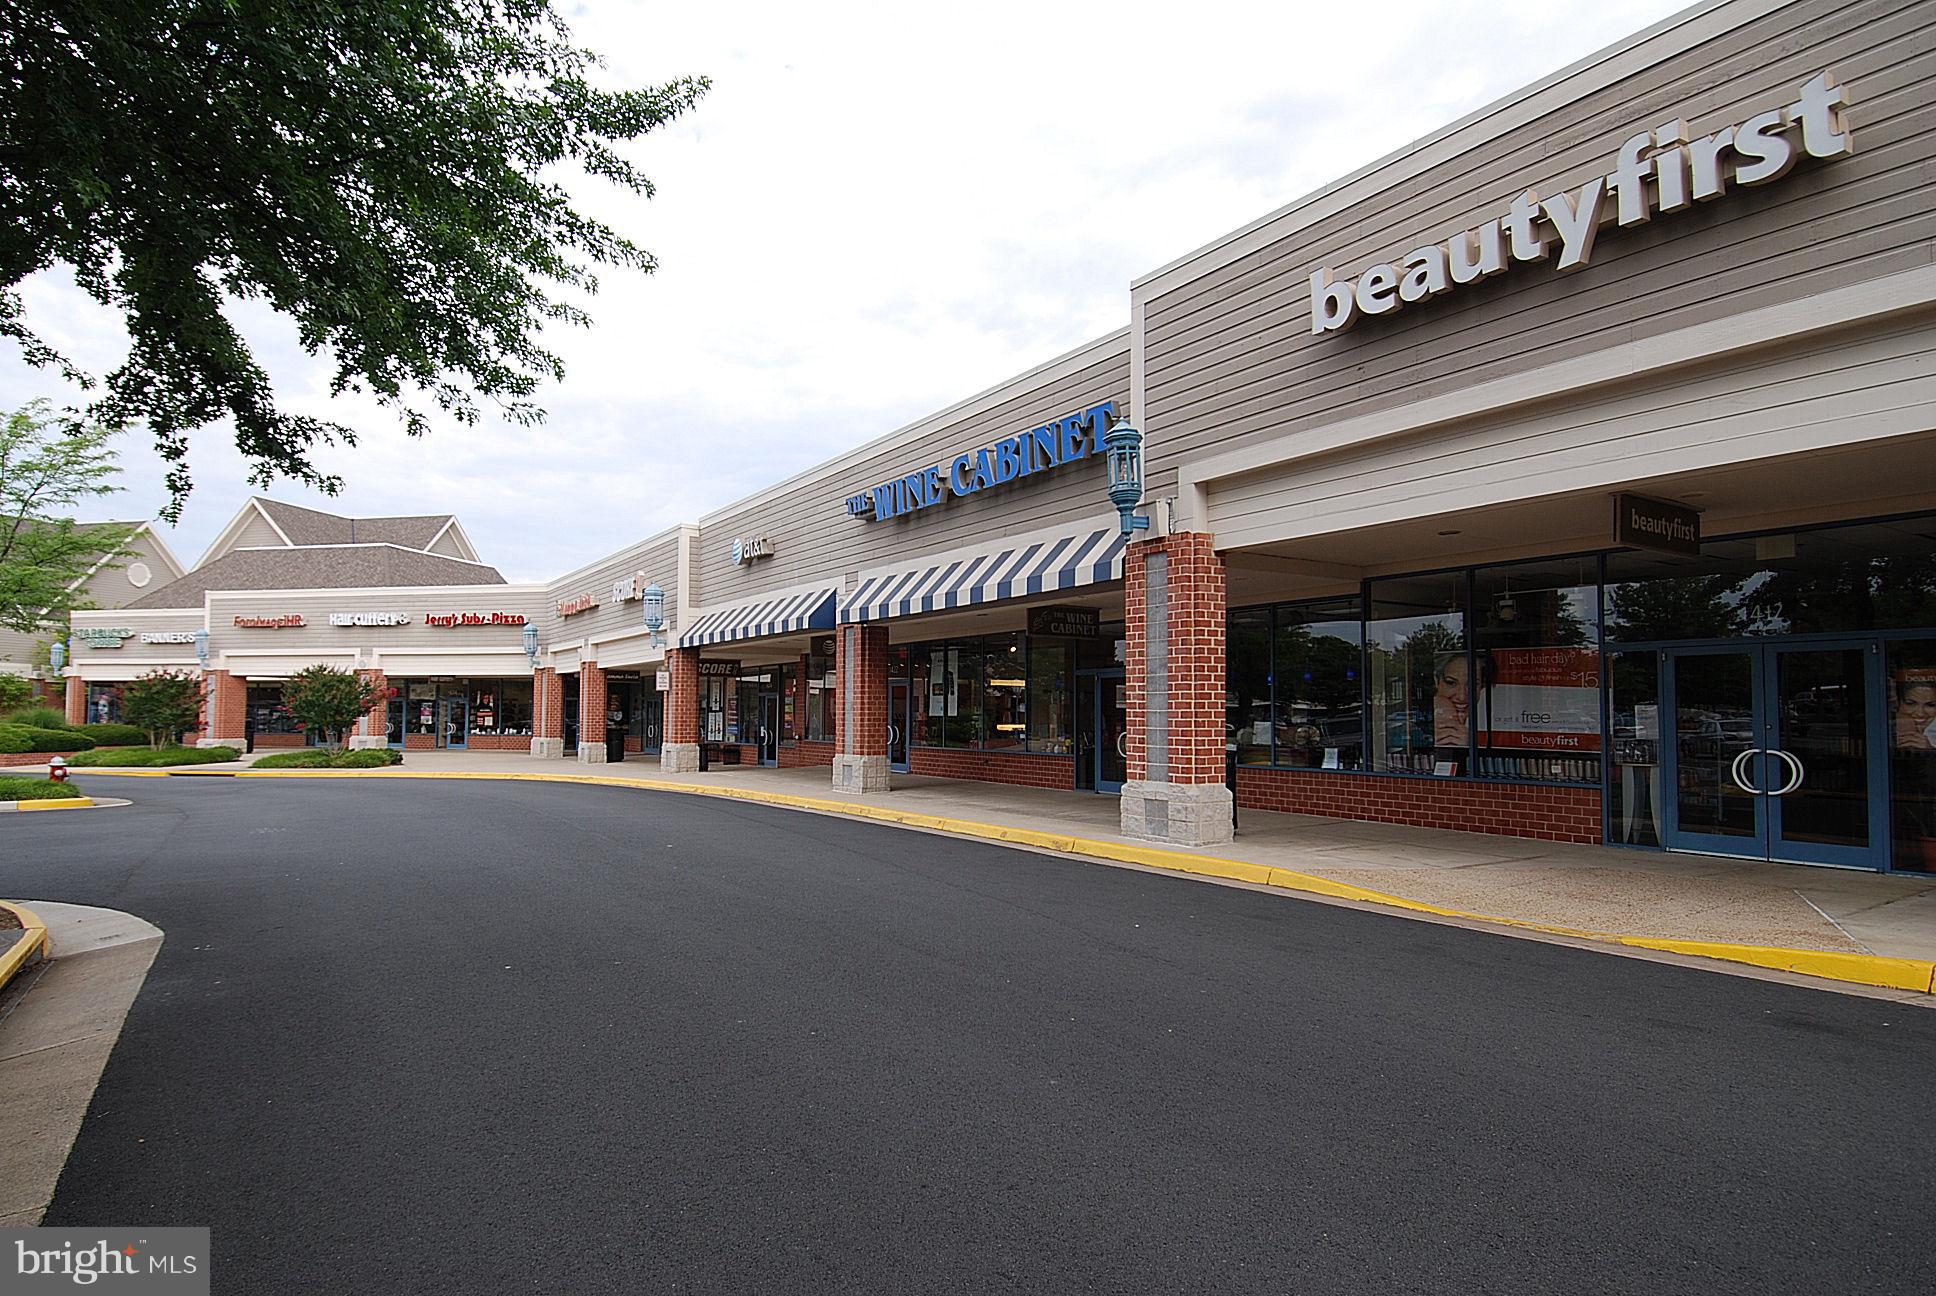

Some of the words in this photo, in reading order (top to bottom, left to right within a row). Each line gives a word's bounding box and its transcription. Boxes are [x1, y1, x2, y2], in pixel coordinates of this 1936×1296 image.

[1309, 70, 1850, 335] beautyfirst
[846, 492, 871, 515] THE
[872, 465, 943, 521] WINE
[951, 401, 1117, 497] CABINET
[1631, 508, 1695, 542] beautyfirst
[425, 613, 459, 628] Jerry's
[491, 611, 527, 625] Pizza
[1066, 612, 1094, 624] WINE
[1050, 623, 1097, 635] CABINET
[1509, 653, 1528, 665] bad
[1531, 653, 1550, 664] hair
[1551, 651, 1576, 667] day?
[1570, 671, 1599, 688] $15
[1521, 710, 1551, 724] free
[1521, 734, 1579, 747] beautyfirst
